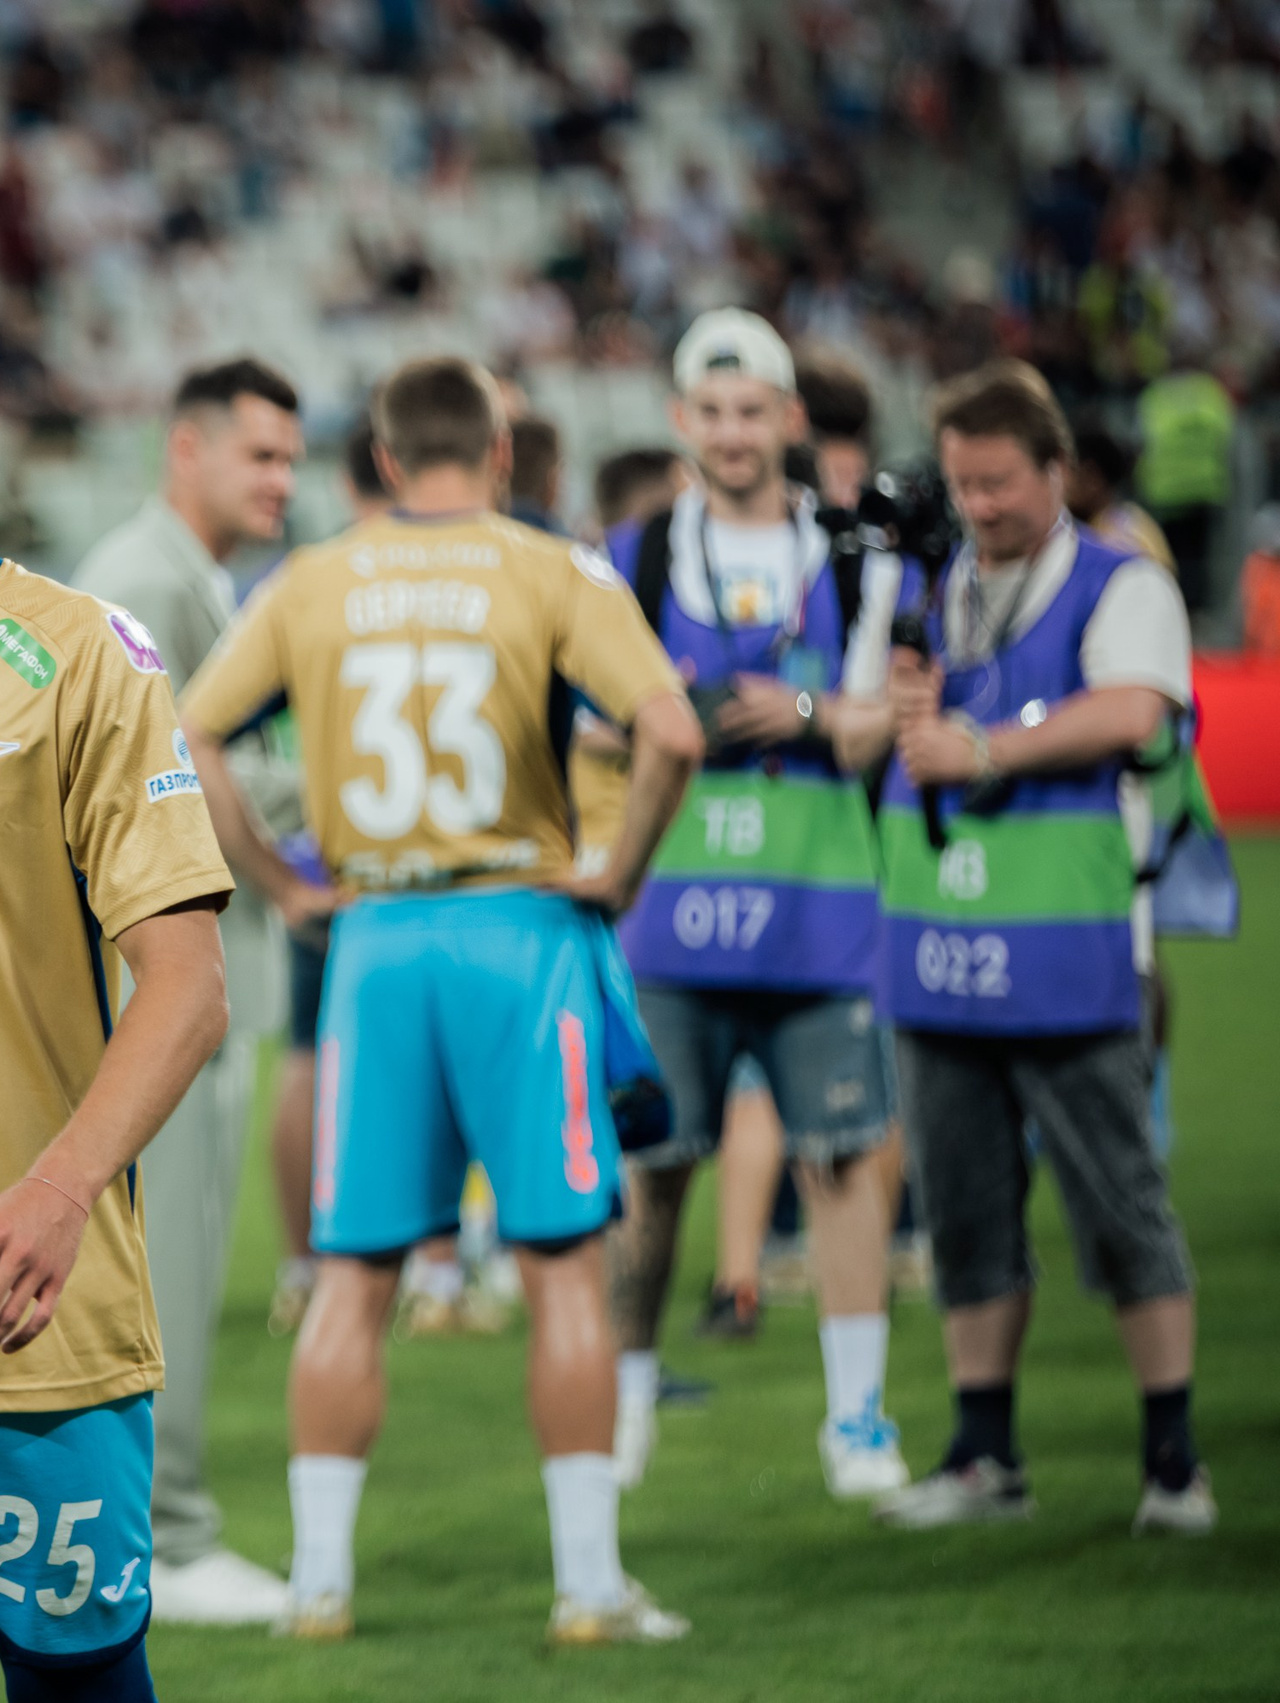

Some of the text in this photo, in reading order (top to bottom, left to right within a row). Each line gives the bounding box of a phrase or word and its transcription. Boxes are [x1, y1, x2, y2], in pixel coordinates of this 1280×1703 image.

[0, 631, 49, 680] МЕГАФОН
[339, 641, 508, 841] 33
[672, 886, 775, 950] 017
[915, 928, 1011, 998] 022
